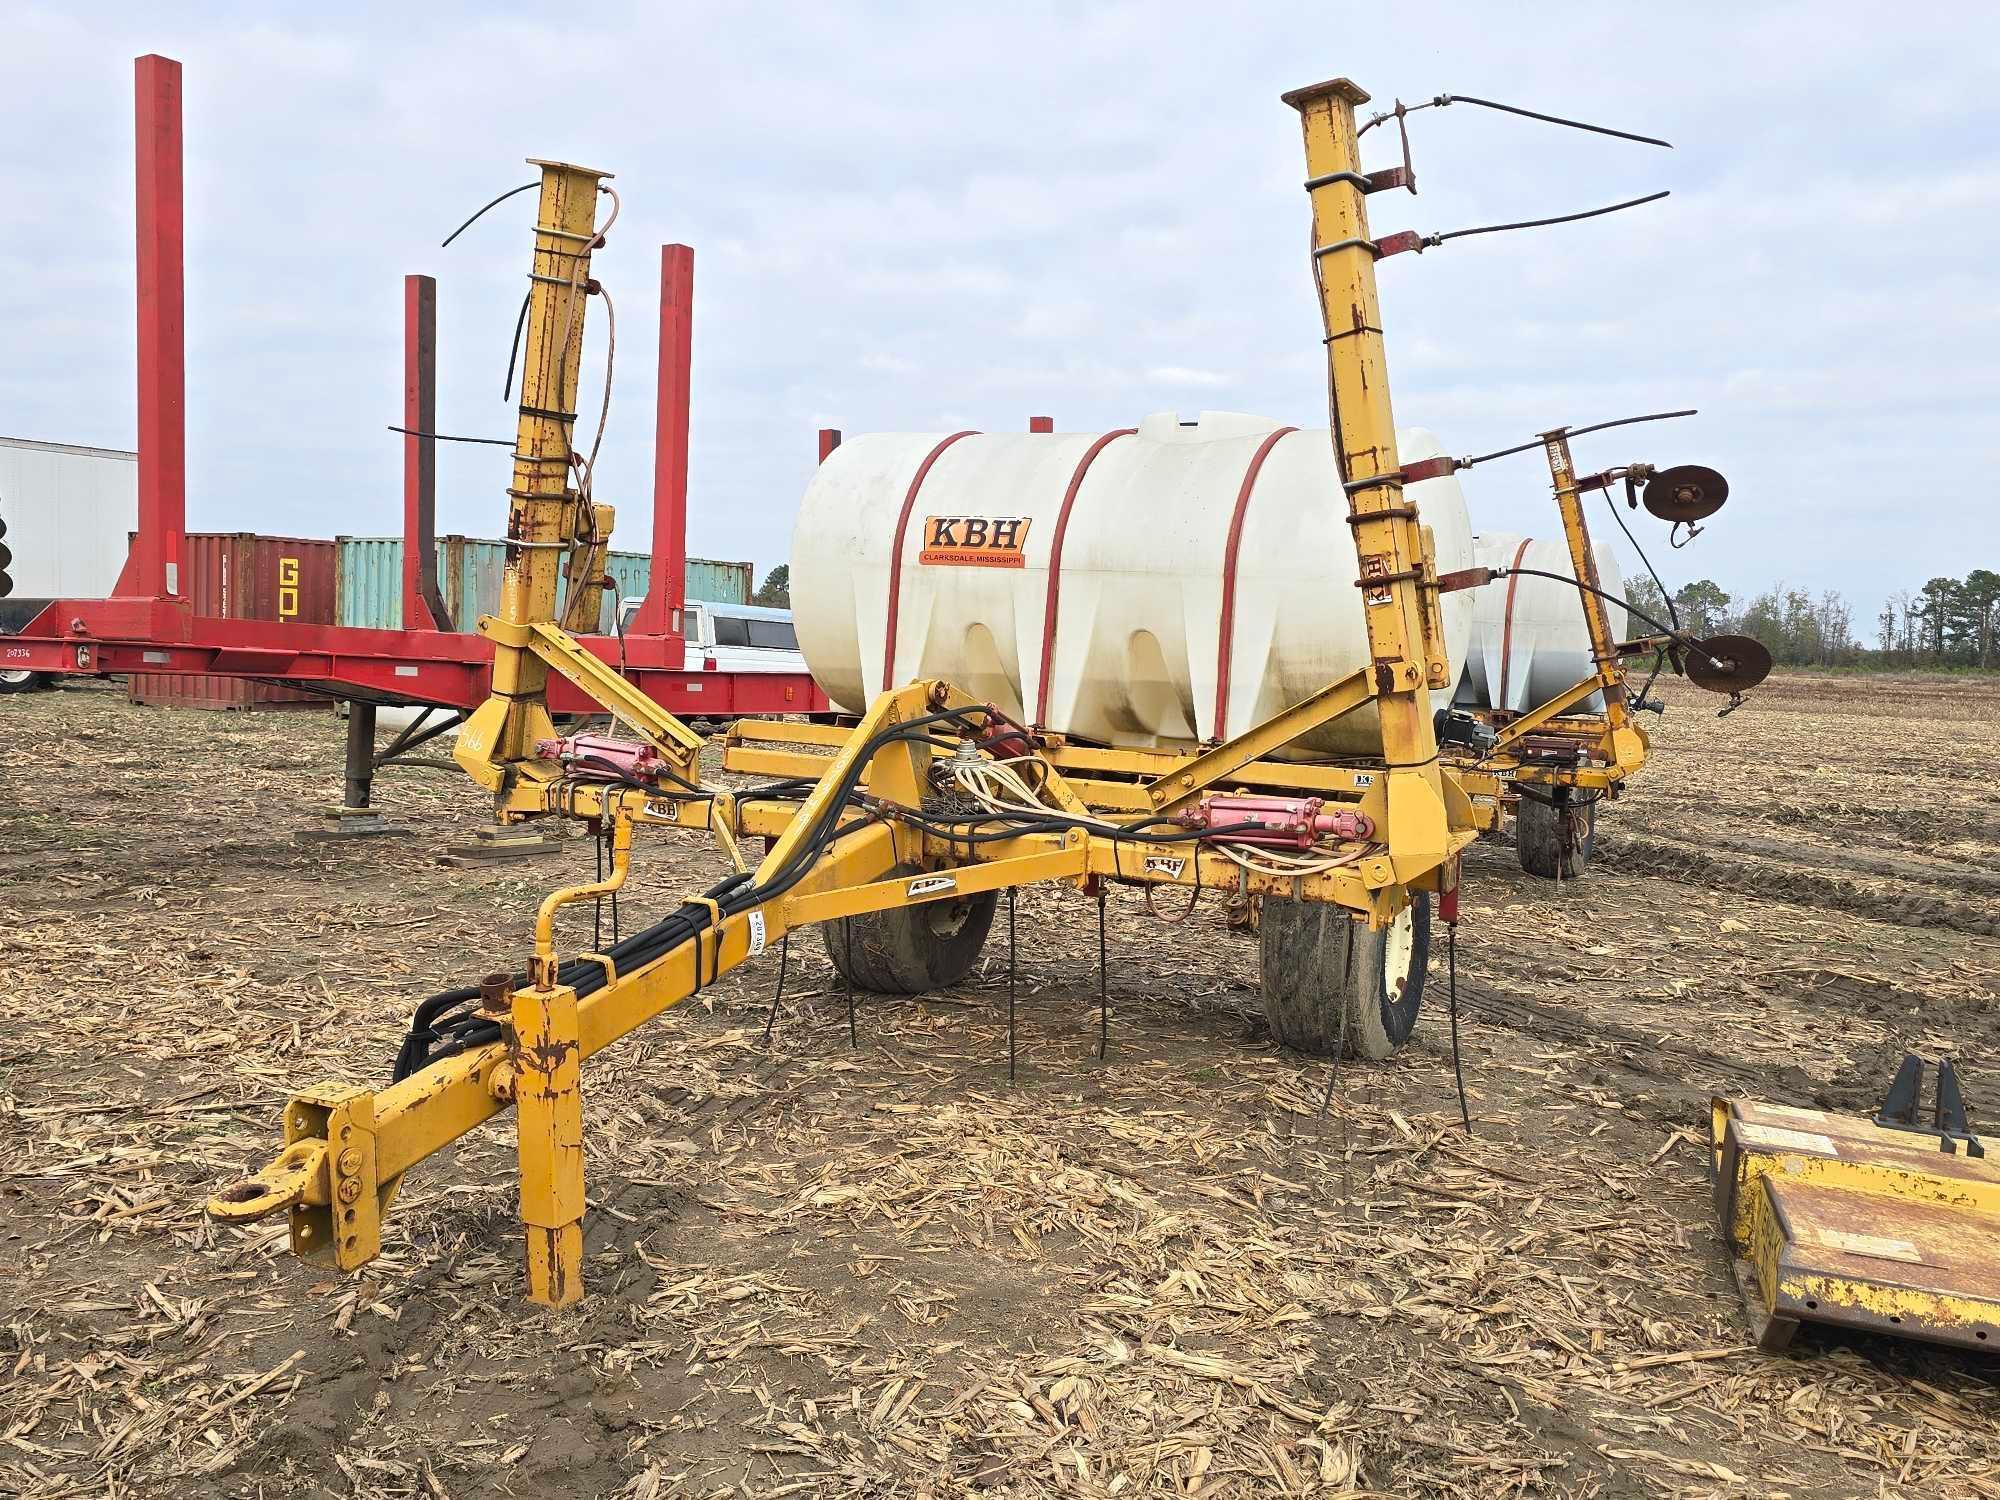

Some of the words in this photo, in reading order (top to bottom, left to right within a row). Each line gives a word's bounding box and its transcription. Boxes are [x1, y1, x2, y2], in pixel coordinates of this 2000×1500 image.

[930, 518, 1022, 548] KBH
[279, 558, 298, 623] GO
[1367, 558, 1385, 601] KH
